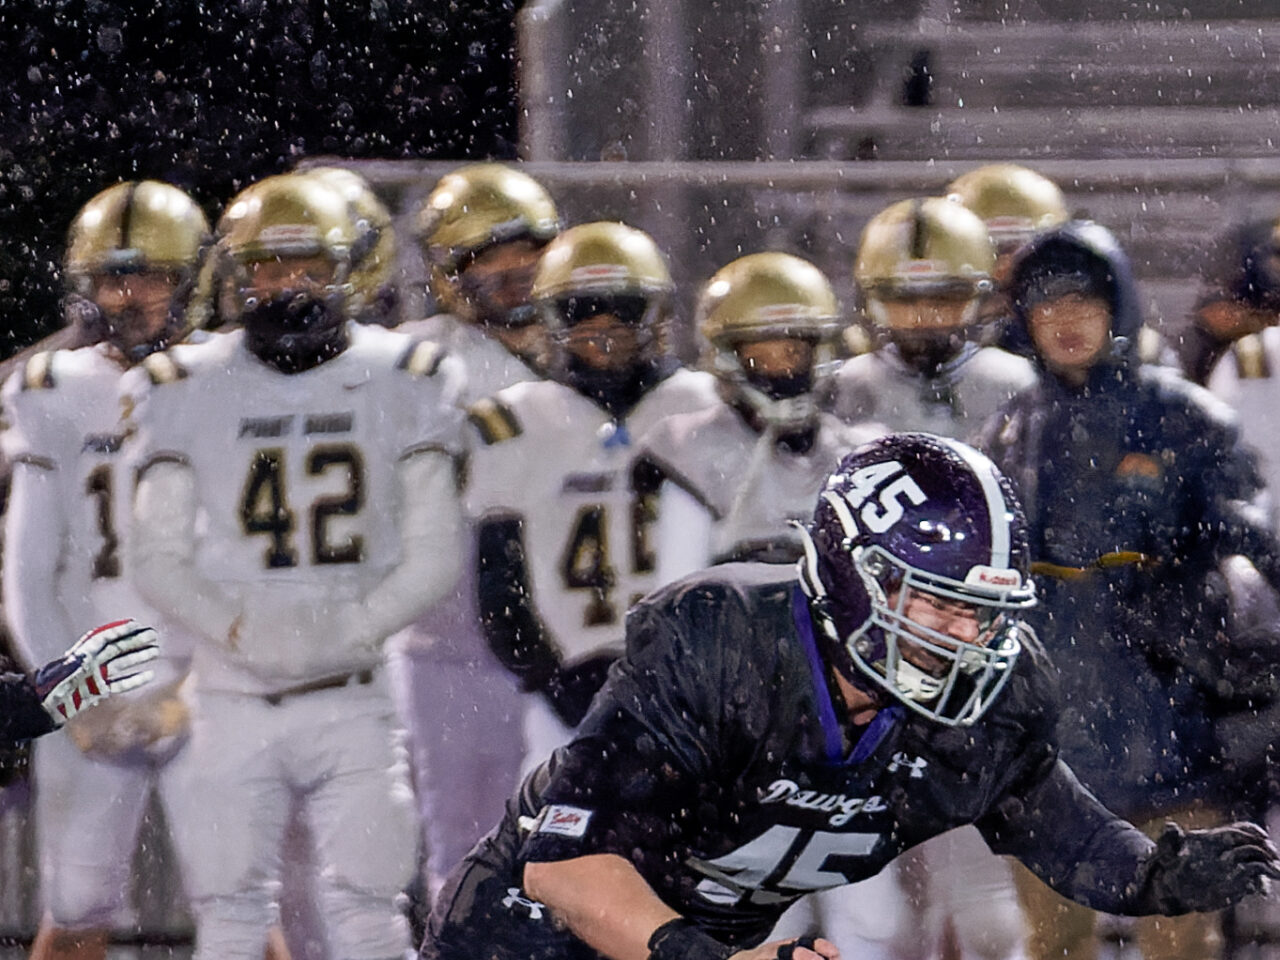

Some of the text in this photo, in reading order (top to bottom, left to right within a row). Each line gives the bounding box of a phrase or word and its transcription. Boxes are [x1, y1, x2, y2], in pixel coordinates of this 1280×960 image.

[239, 442, 366, 570] 42
[846, 460, 929, 534] 45
[759, 778, 888, 827] Dawgs
[684, 823, 882, 905] 45
